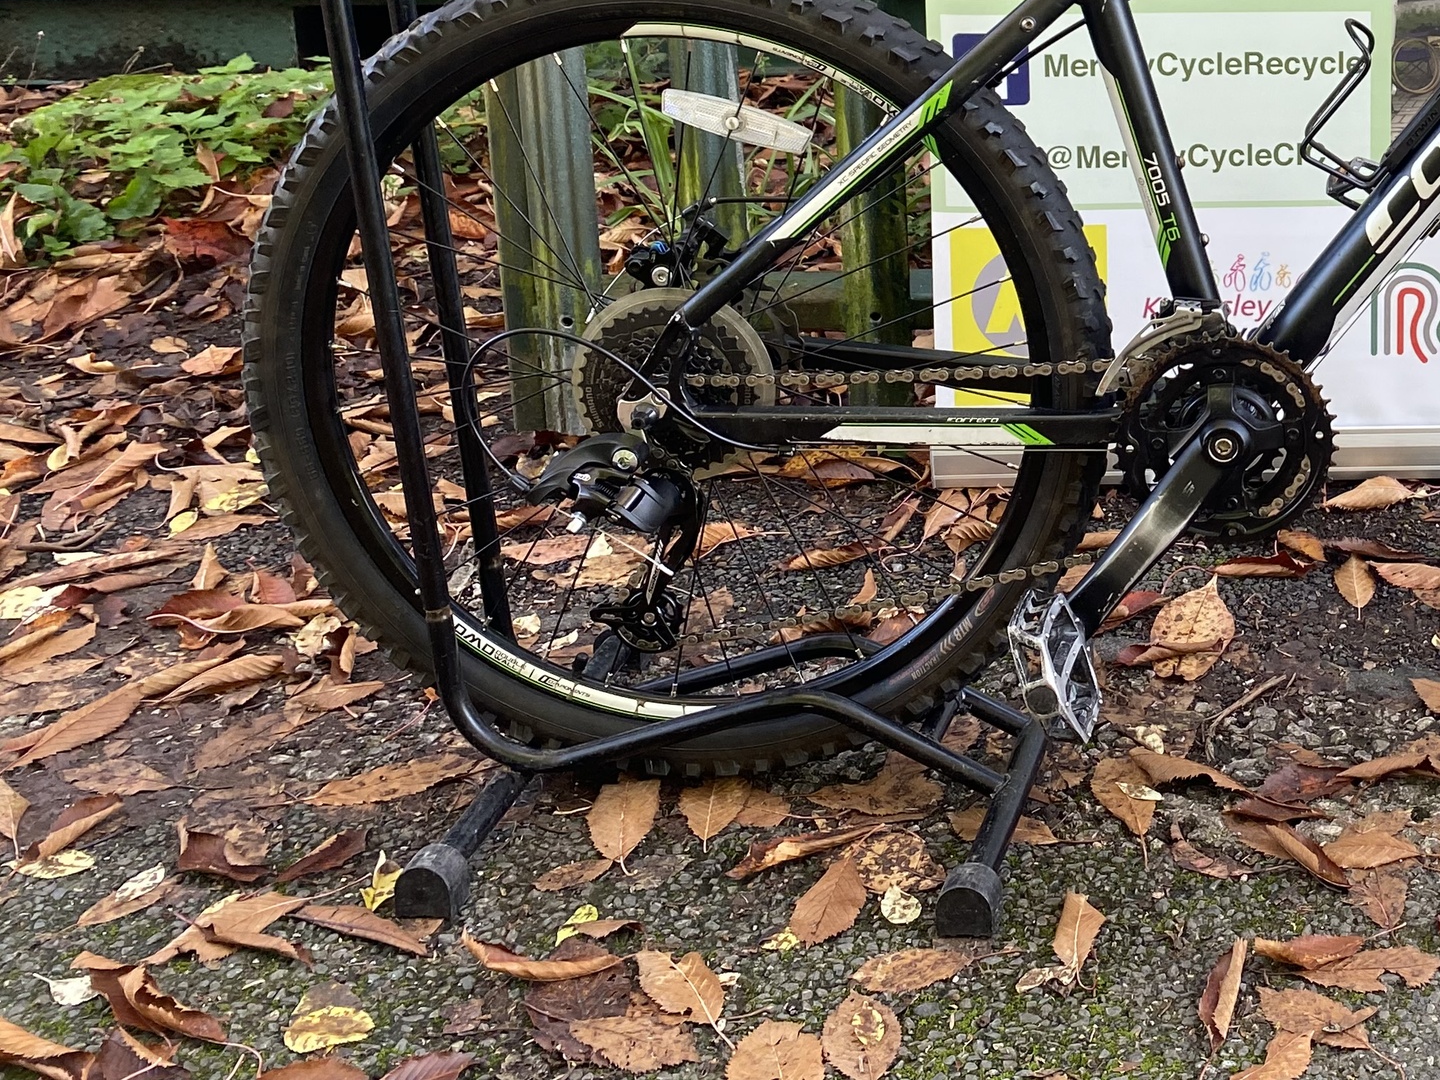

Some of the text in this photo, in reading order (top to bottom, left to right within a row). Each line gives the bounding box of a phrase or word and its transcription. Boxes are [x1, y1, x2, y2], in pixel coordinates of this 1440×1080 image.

[877, 120, 913, 153] GEOMETRY
[1144, 153, 1170, 206] 7005
[1163, 212, 1181, 242] T6
[953, 616, 974, 641] MTB
